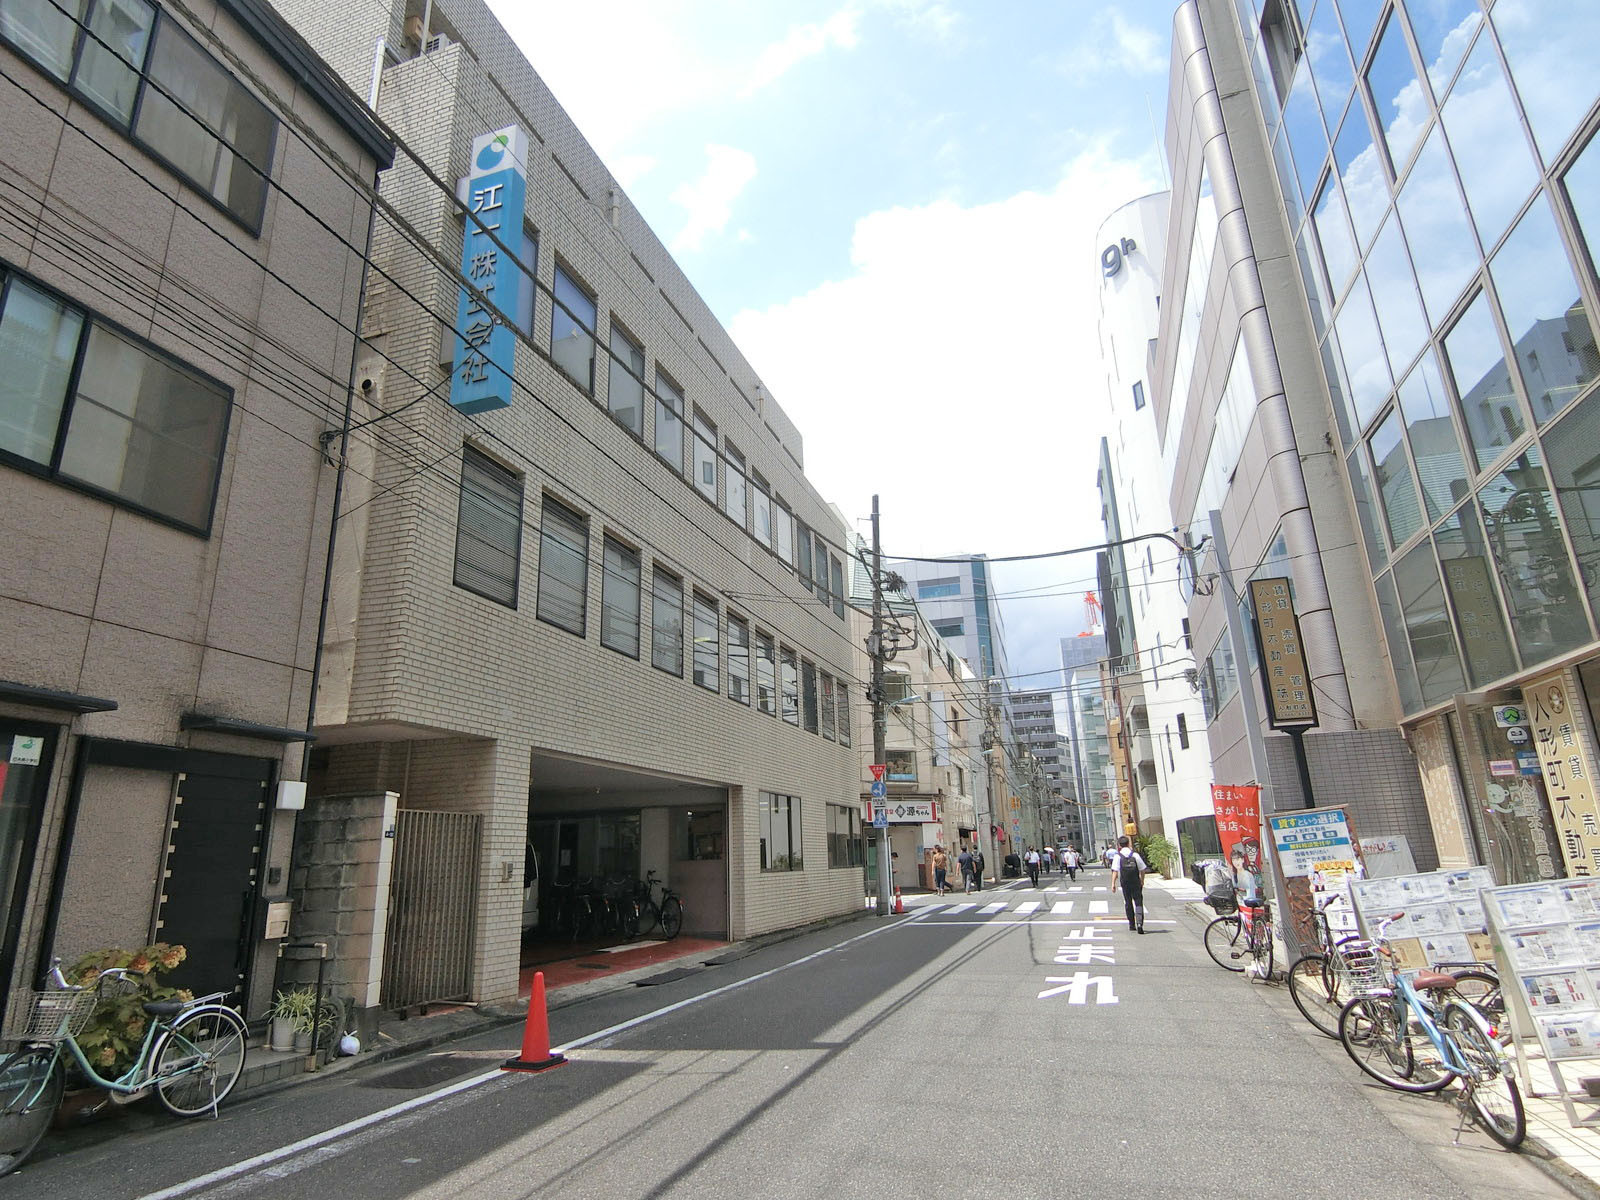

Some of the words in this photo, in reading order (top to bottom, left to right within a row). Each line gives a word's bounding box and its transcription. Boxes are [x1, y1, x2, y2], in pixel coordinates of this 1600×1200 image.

[461, 183, 504, 384] 江一株式会社
[1273, 585, 1289, 609] 賃貸
[1282, 629, 1297, 655] 売買
[1290, 675, 1305, 702] 管理
[1214, 789, 1243, 800] 住まい
[906, 806, 930, 816] 源ちゃん
[1216, 806, 1259, 817] さがしは、
[1218, 821, 1253, 833] 当店へ。
[1277, 813, 1340, 829] 貸すという選択
[1037, 926, 1120, 1005] 止まれ
